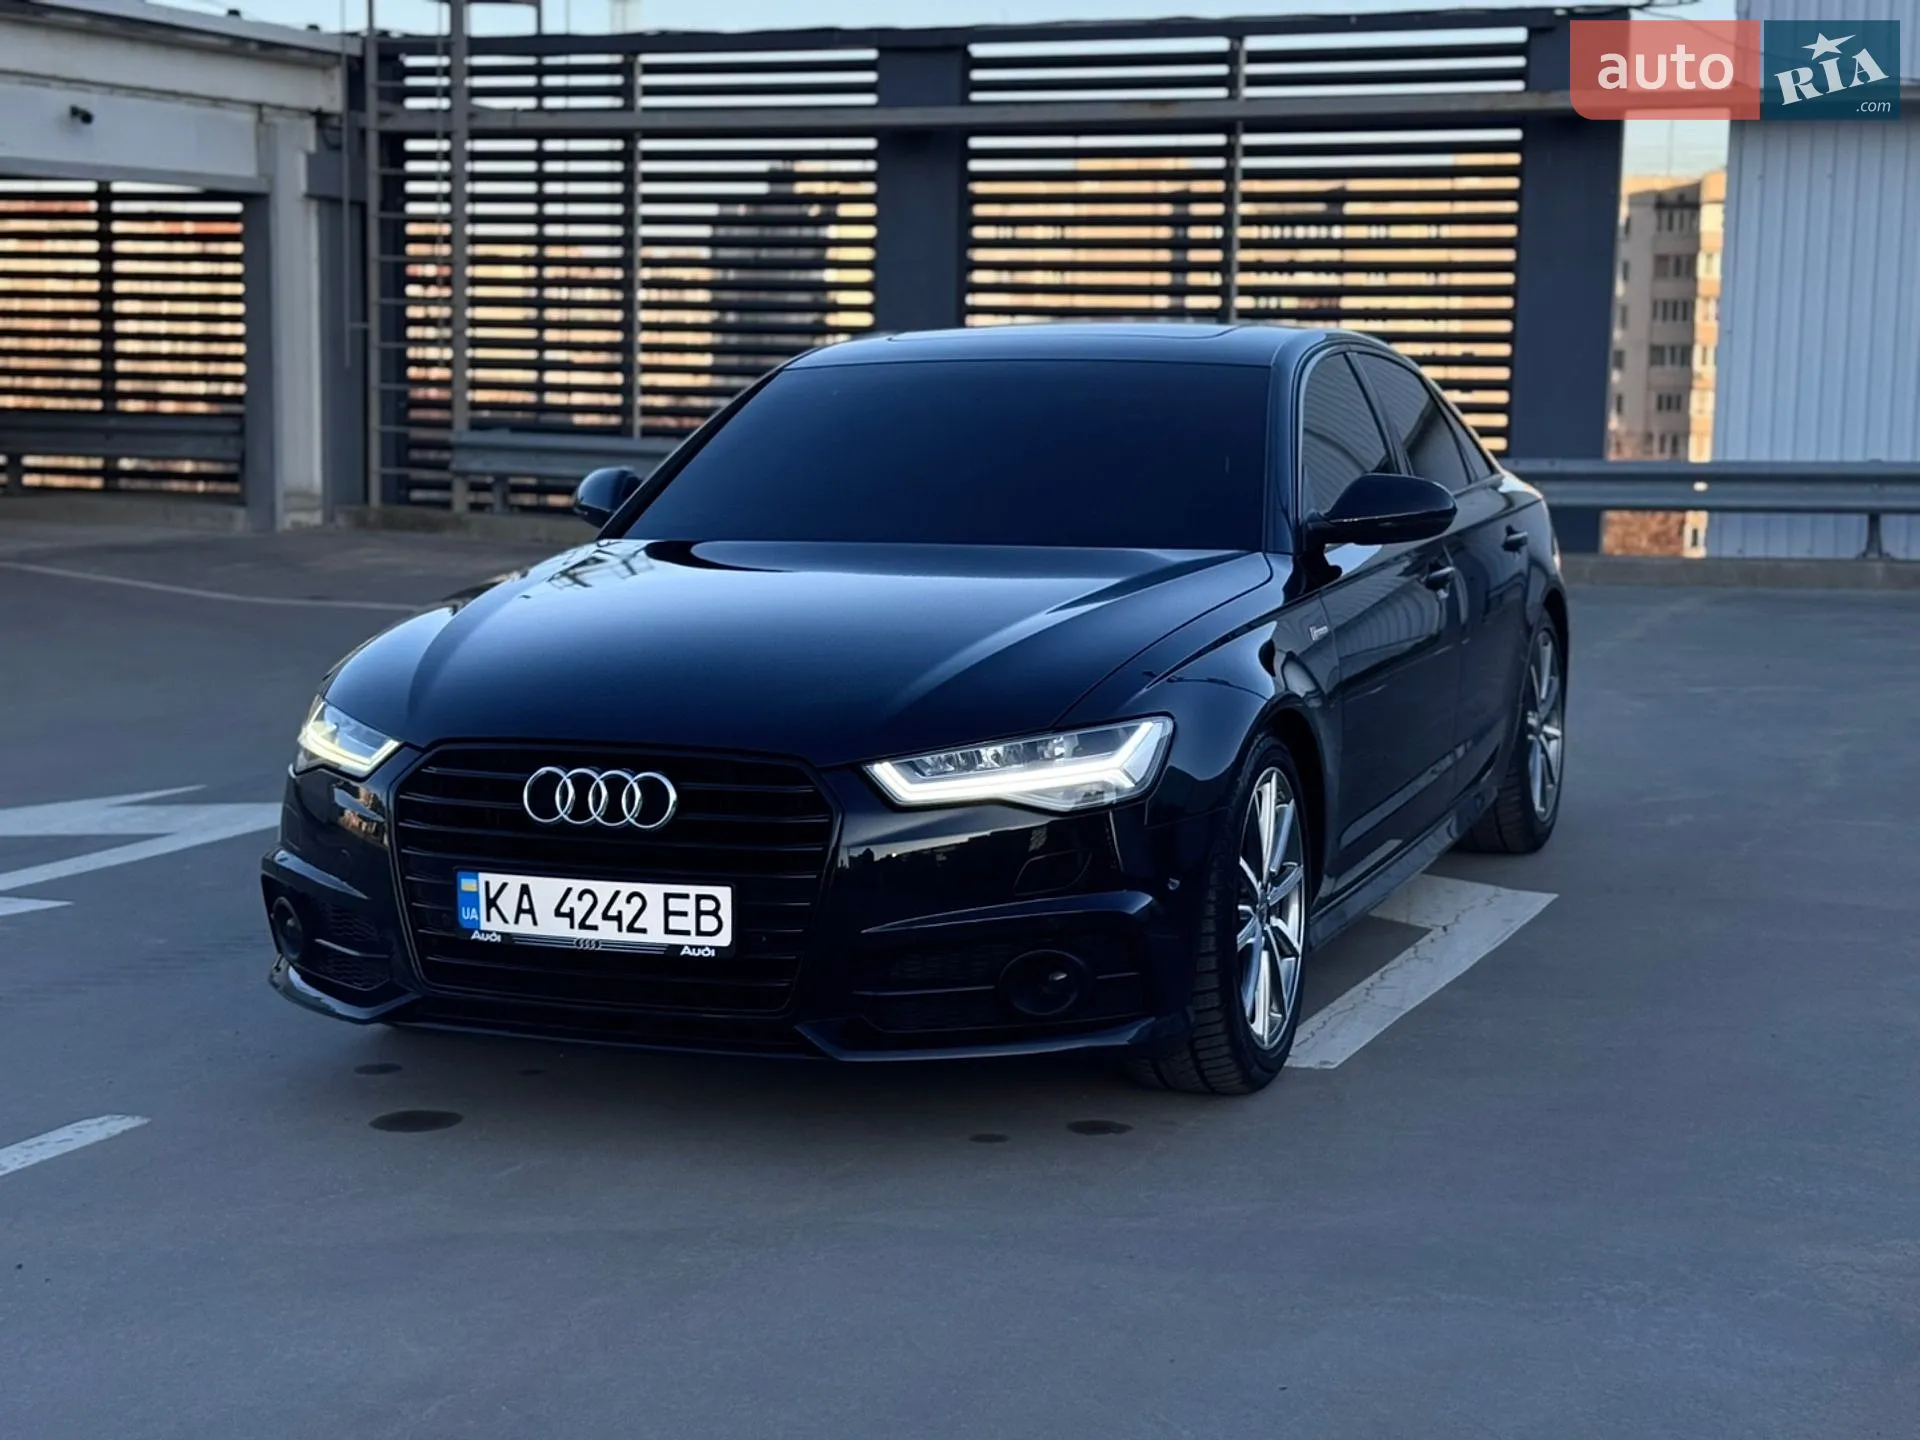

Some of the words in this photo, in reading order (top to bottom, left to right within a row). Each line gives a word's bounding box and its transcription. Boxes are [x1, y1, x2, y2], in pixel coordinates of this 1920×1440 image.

[461, 907, 479, 920] UA
[484, 881, 538, 926] KA
[554, 887, 648, 934] 4242
[663, 892, 724, 937] EB
